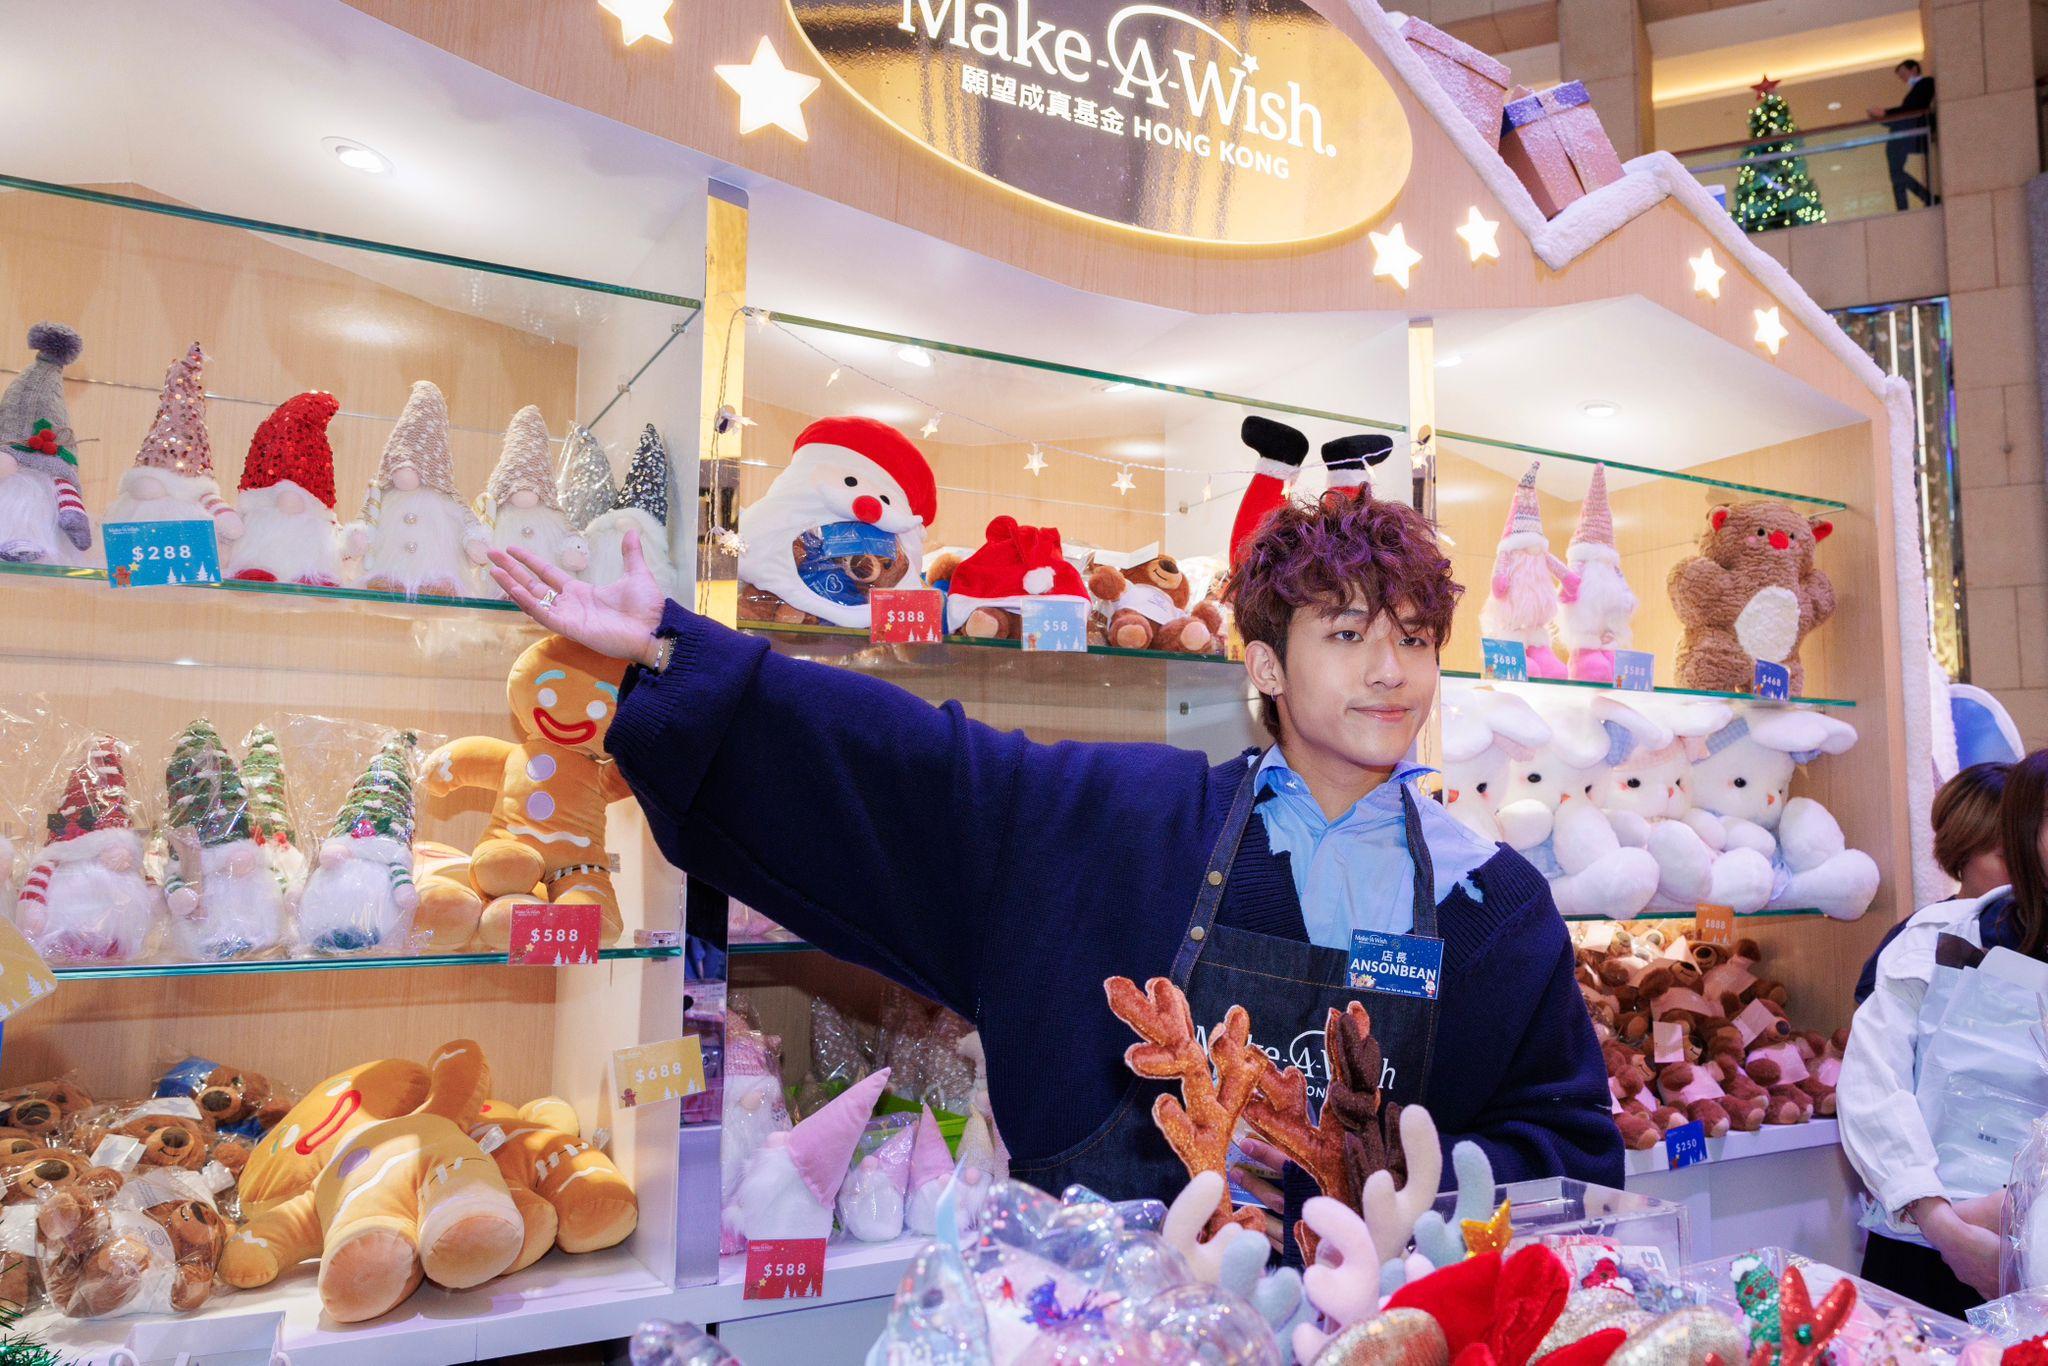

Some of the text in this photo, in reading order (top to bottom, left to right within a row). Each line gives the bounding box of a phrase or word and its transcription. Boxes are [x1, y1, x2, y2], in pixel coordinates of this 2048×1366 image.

[961, 64, 1290, 179] 願望成真基金 HONG KONG
[131, 545, 191, 562] $288
[887, 609, 925, 623] $388
[1043, 620, 1068, 632] $58
[530, 927, 578, 944] $588
[1350, 958, 1437, 981] ANSONBEAN
[635, 1062, 682, 1084] $688
[1675, 1138, 1697, 1153] $250
[763, 1262, 806, 1278] $588
